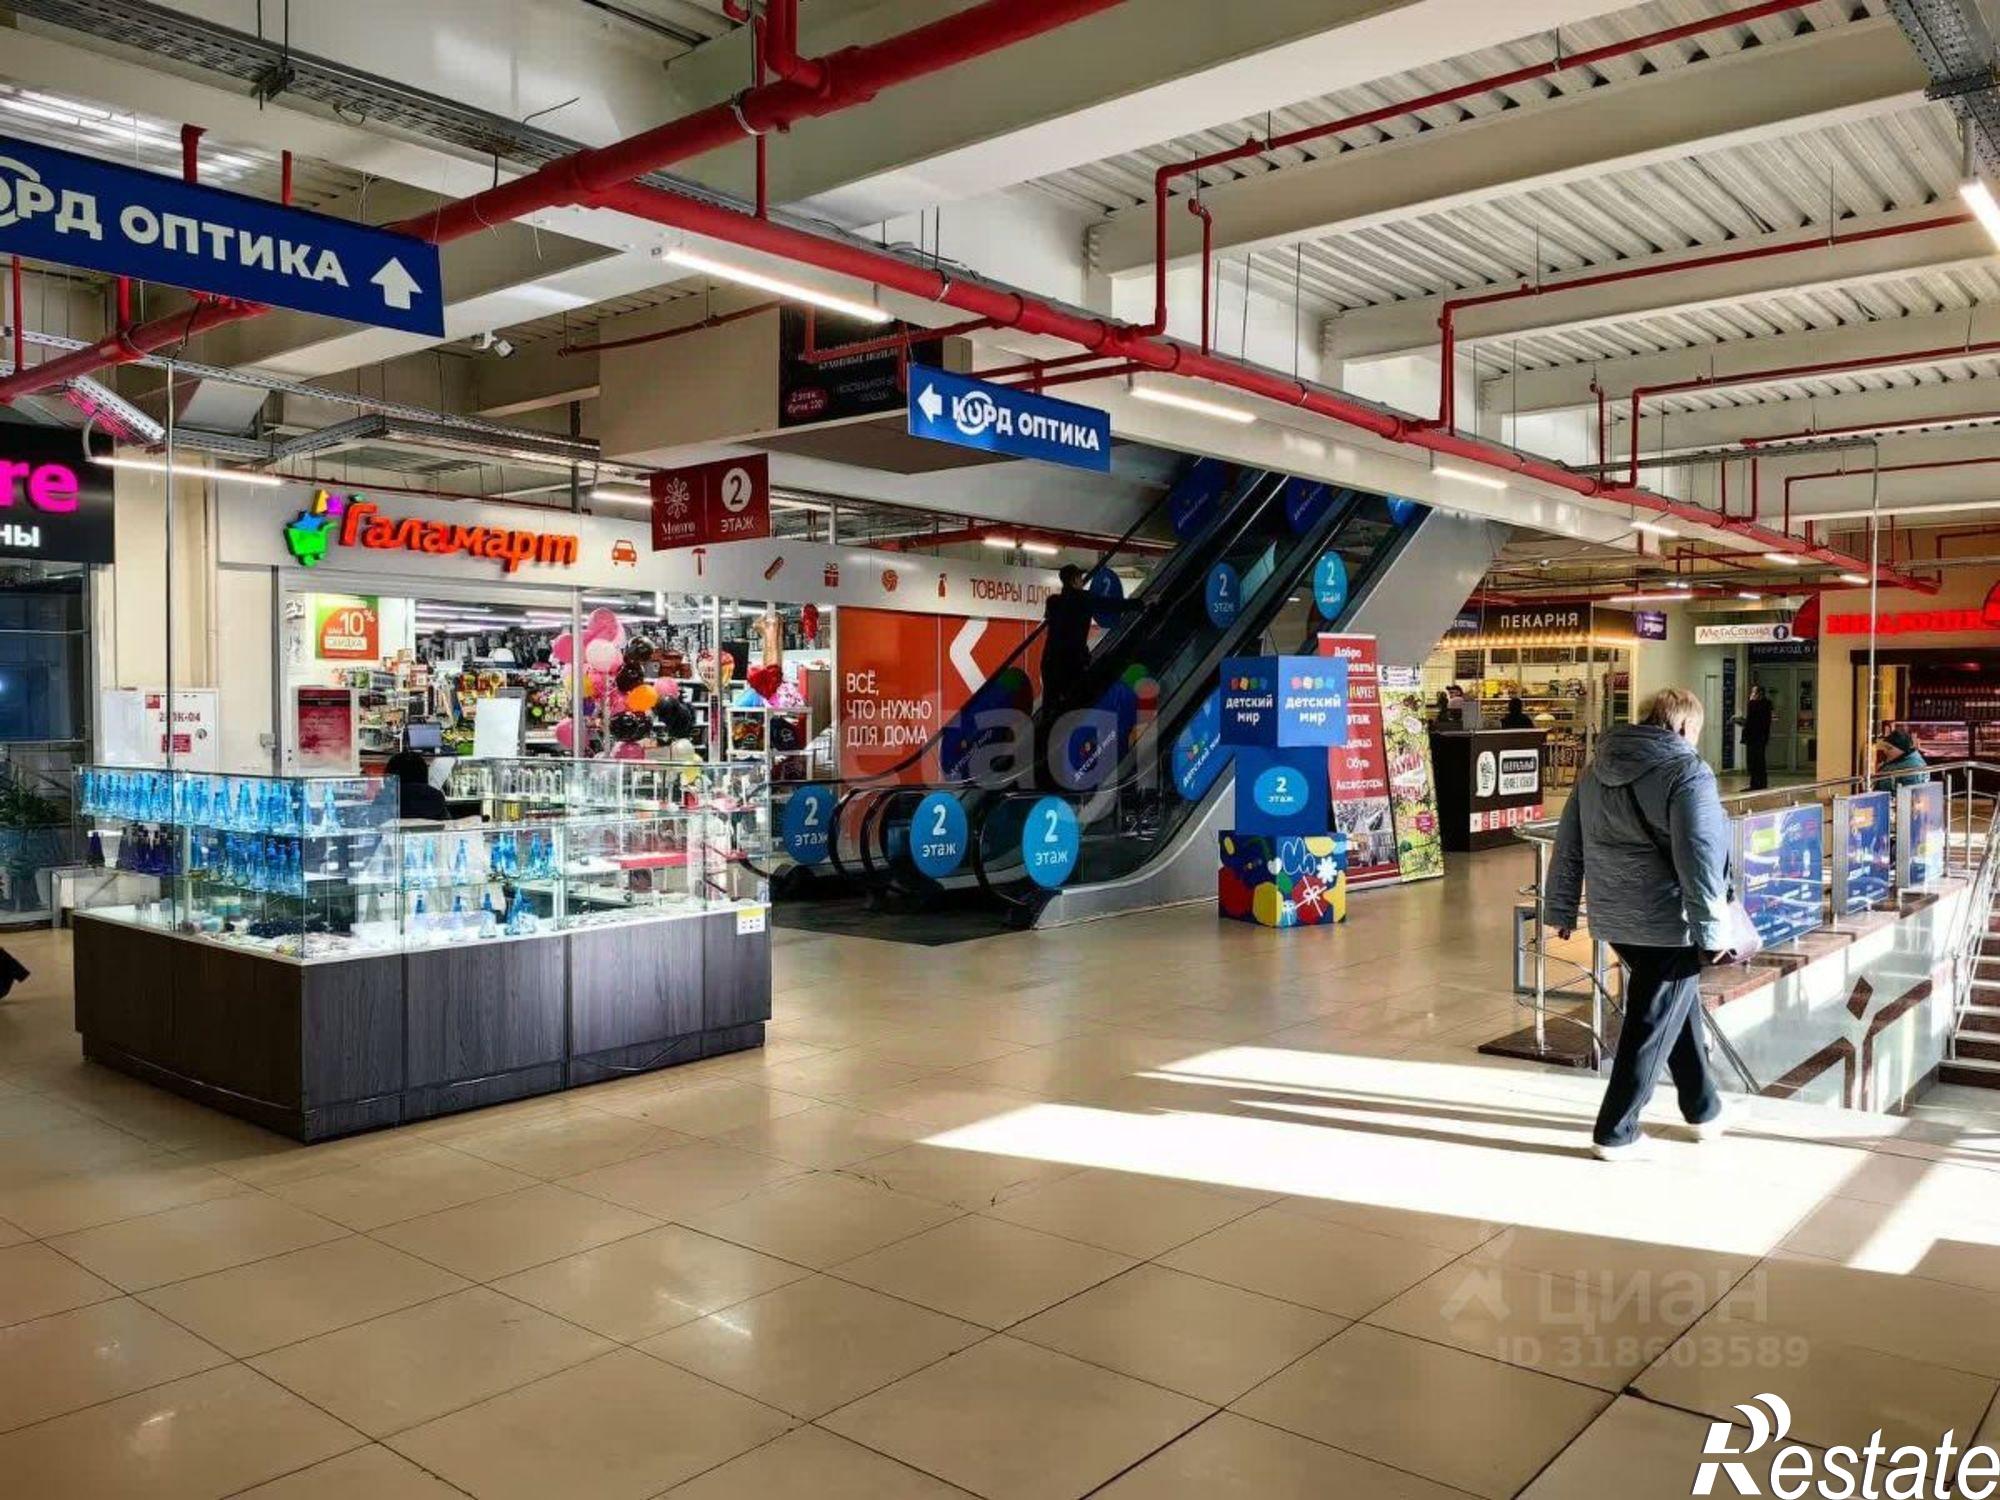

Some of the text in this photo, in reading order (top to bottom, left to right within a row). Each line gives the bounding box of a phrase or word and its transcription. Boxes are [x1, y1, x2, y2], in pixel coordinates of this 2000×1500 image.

[119, 205, 350, 288] ОПТИКА
[952, 391, 1100, 451] КОРД ОПТИКА
[729, 474, 744, 506] 2
[720, 515, 755, 533] ЭТАЖ
[340, 502, 578, 573] Галамарт
[1219, 573, 1228, 596] 2
[1326, 561, 1336, 586] 2
[970, 578, 1023, 602] ТОВАРЫ
[1500, 612, 1580, 630] ПЕКАРНЯ
[846, 669, 880, 696] ВСЁ,
[846, 699, 932, 721] ЧТО НУЖНО
[1224, 693, 1274, 710] детский
[1284, 693, 1342, 710] детский
[1237, 711, 1261, 726] мир
[1299, 711, 1327, 727] мир
[846, 725, 929, 748] ДЛЯ ДОМА
[1276, 776, 1288, 793] 2
[803, 796, 819, 827] 2
[932, 804, 947, 836] 2
[1044, 809, 1059, 843] 2
[922, 842, 958, 859] этаж
[1034, 850, 1069, 867] этаж
